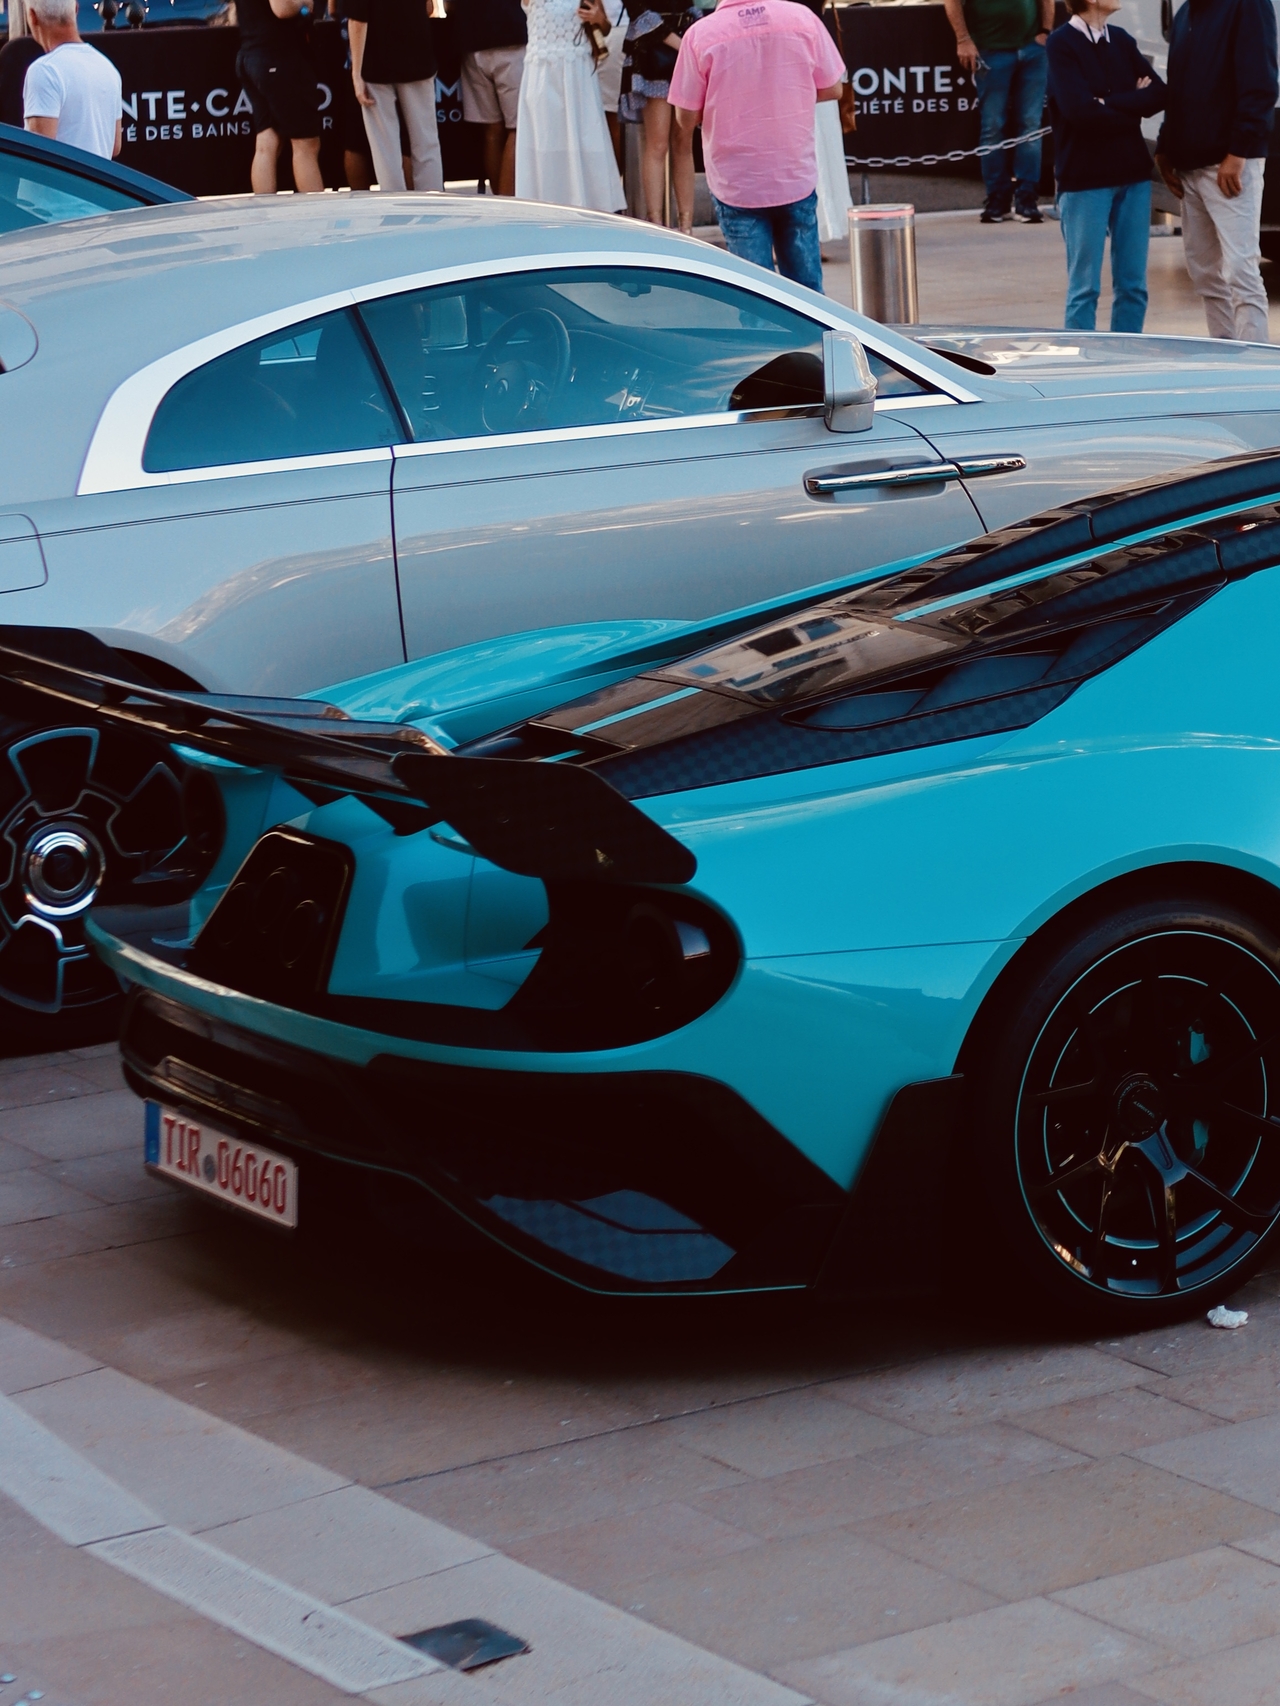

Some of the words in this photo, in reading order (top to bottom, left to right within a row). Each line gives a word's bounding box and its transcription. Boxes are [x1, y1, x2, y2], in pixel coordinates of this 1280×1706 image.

[738, 6, 766, 17] CAMP
[852, 66, 953, 96] ONTE
[912, 98, 950, 113] DES
[145, 124, 183, 141] DES
[192, 121, 251, 138] BAINS
[163, 1113, 201, 1178] TIR
[217, 1138, 287, 1215] 06060
